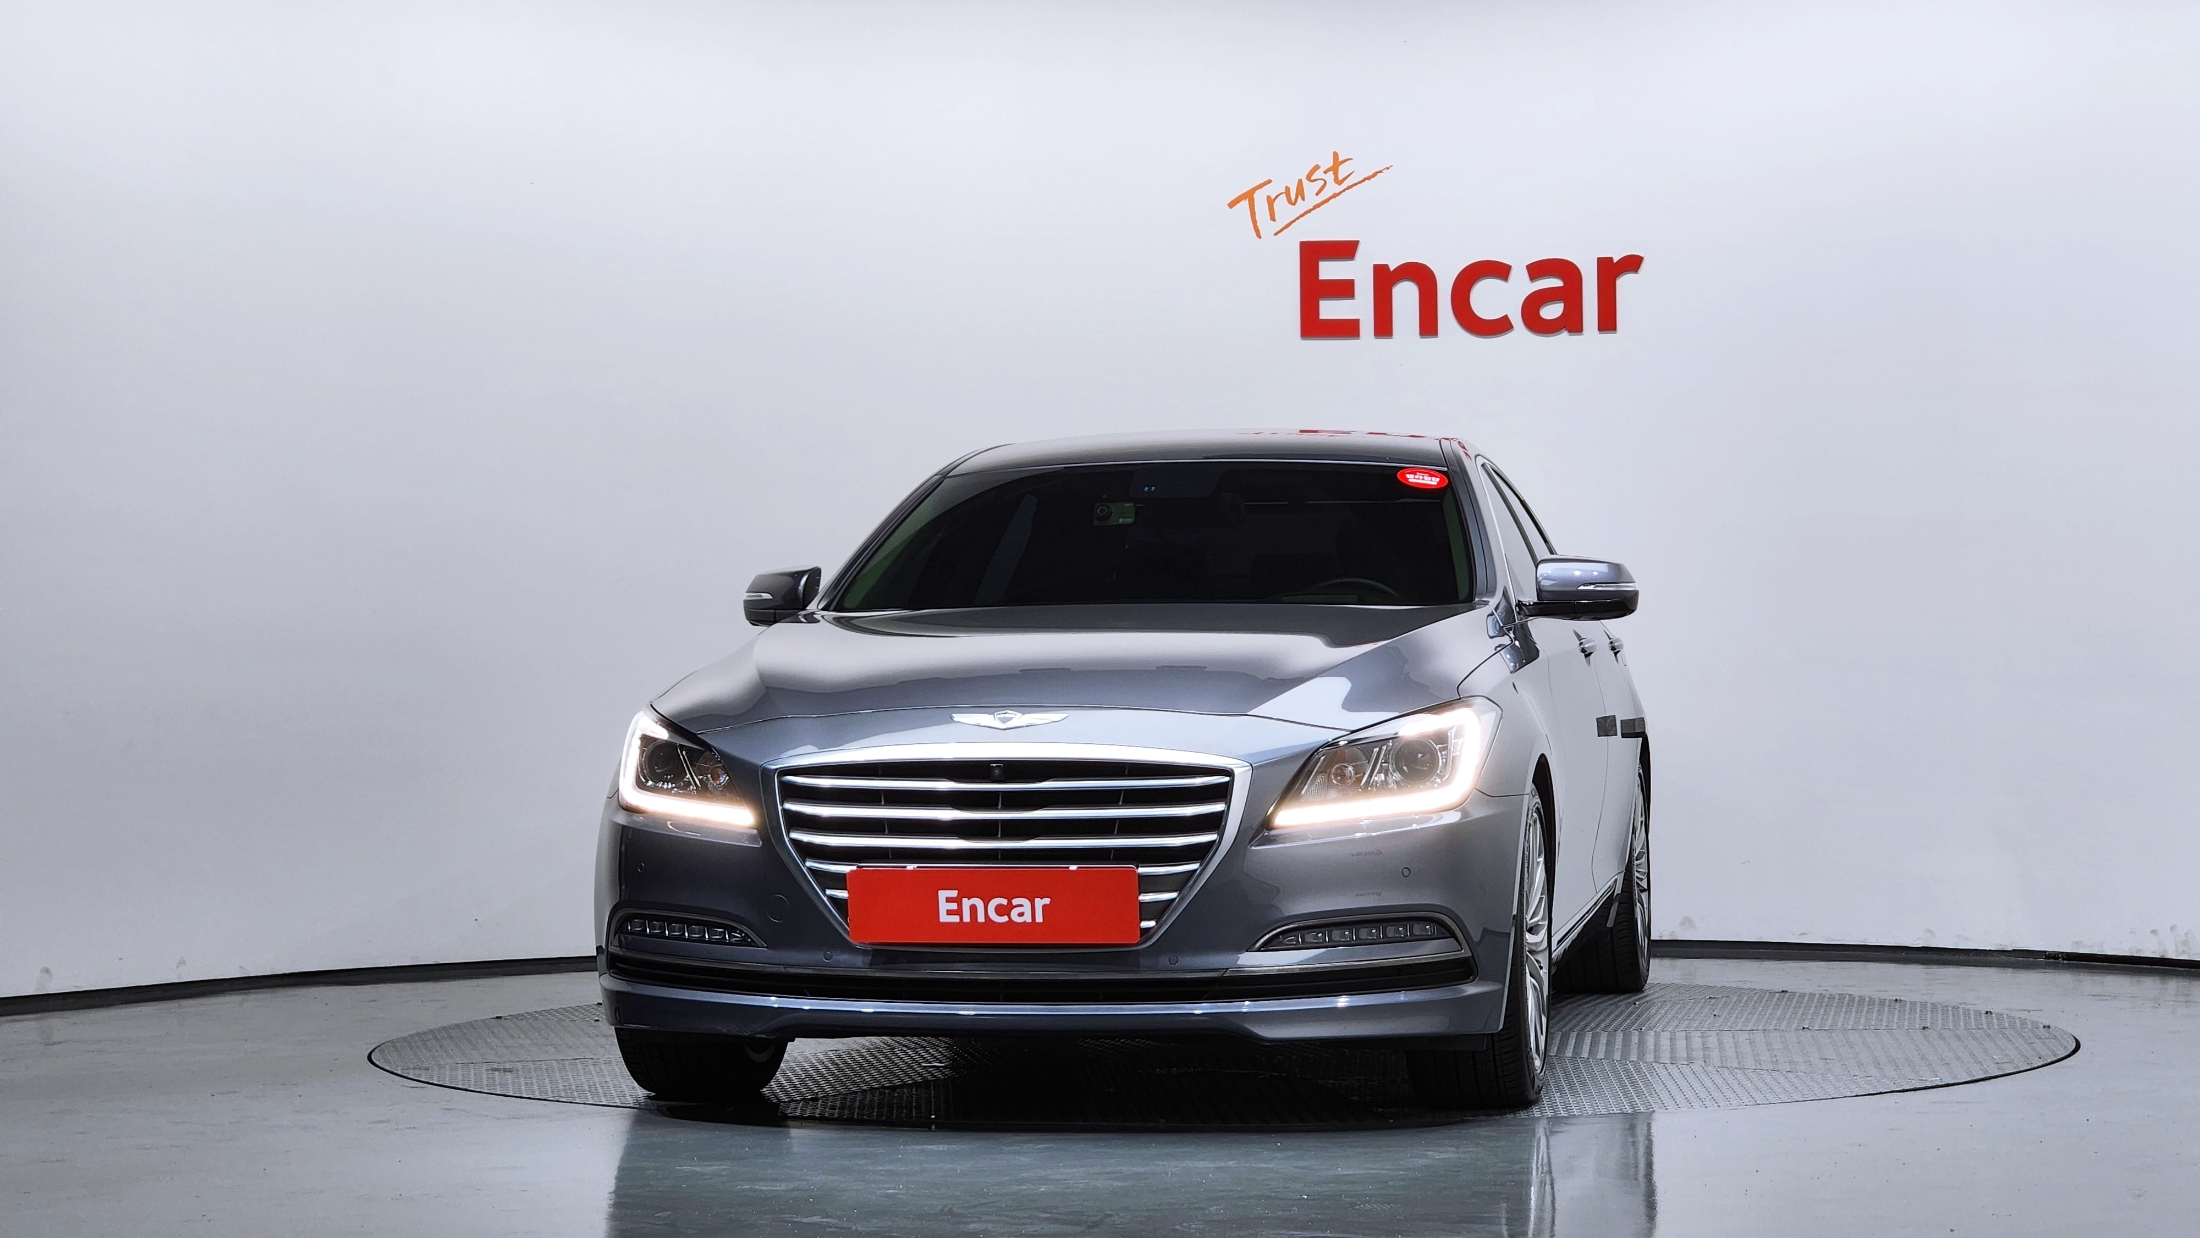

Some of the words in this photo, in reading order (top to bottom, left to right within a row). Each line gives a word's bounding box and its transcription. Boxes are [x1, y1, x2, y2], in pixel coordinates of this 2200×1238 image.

[1227, 151, 1355, 240] Trust
[1299, 240, 1645, 338] Encar
[938, 889, 1051, 923] Encar
